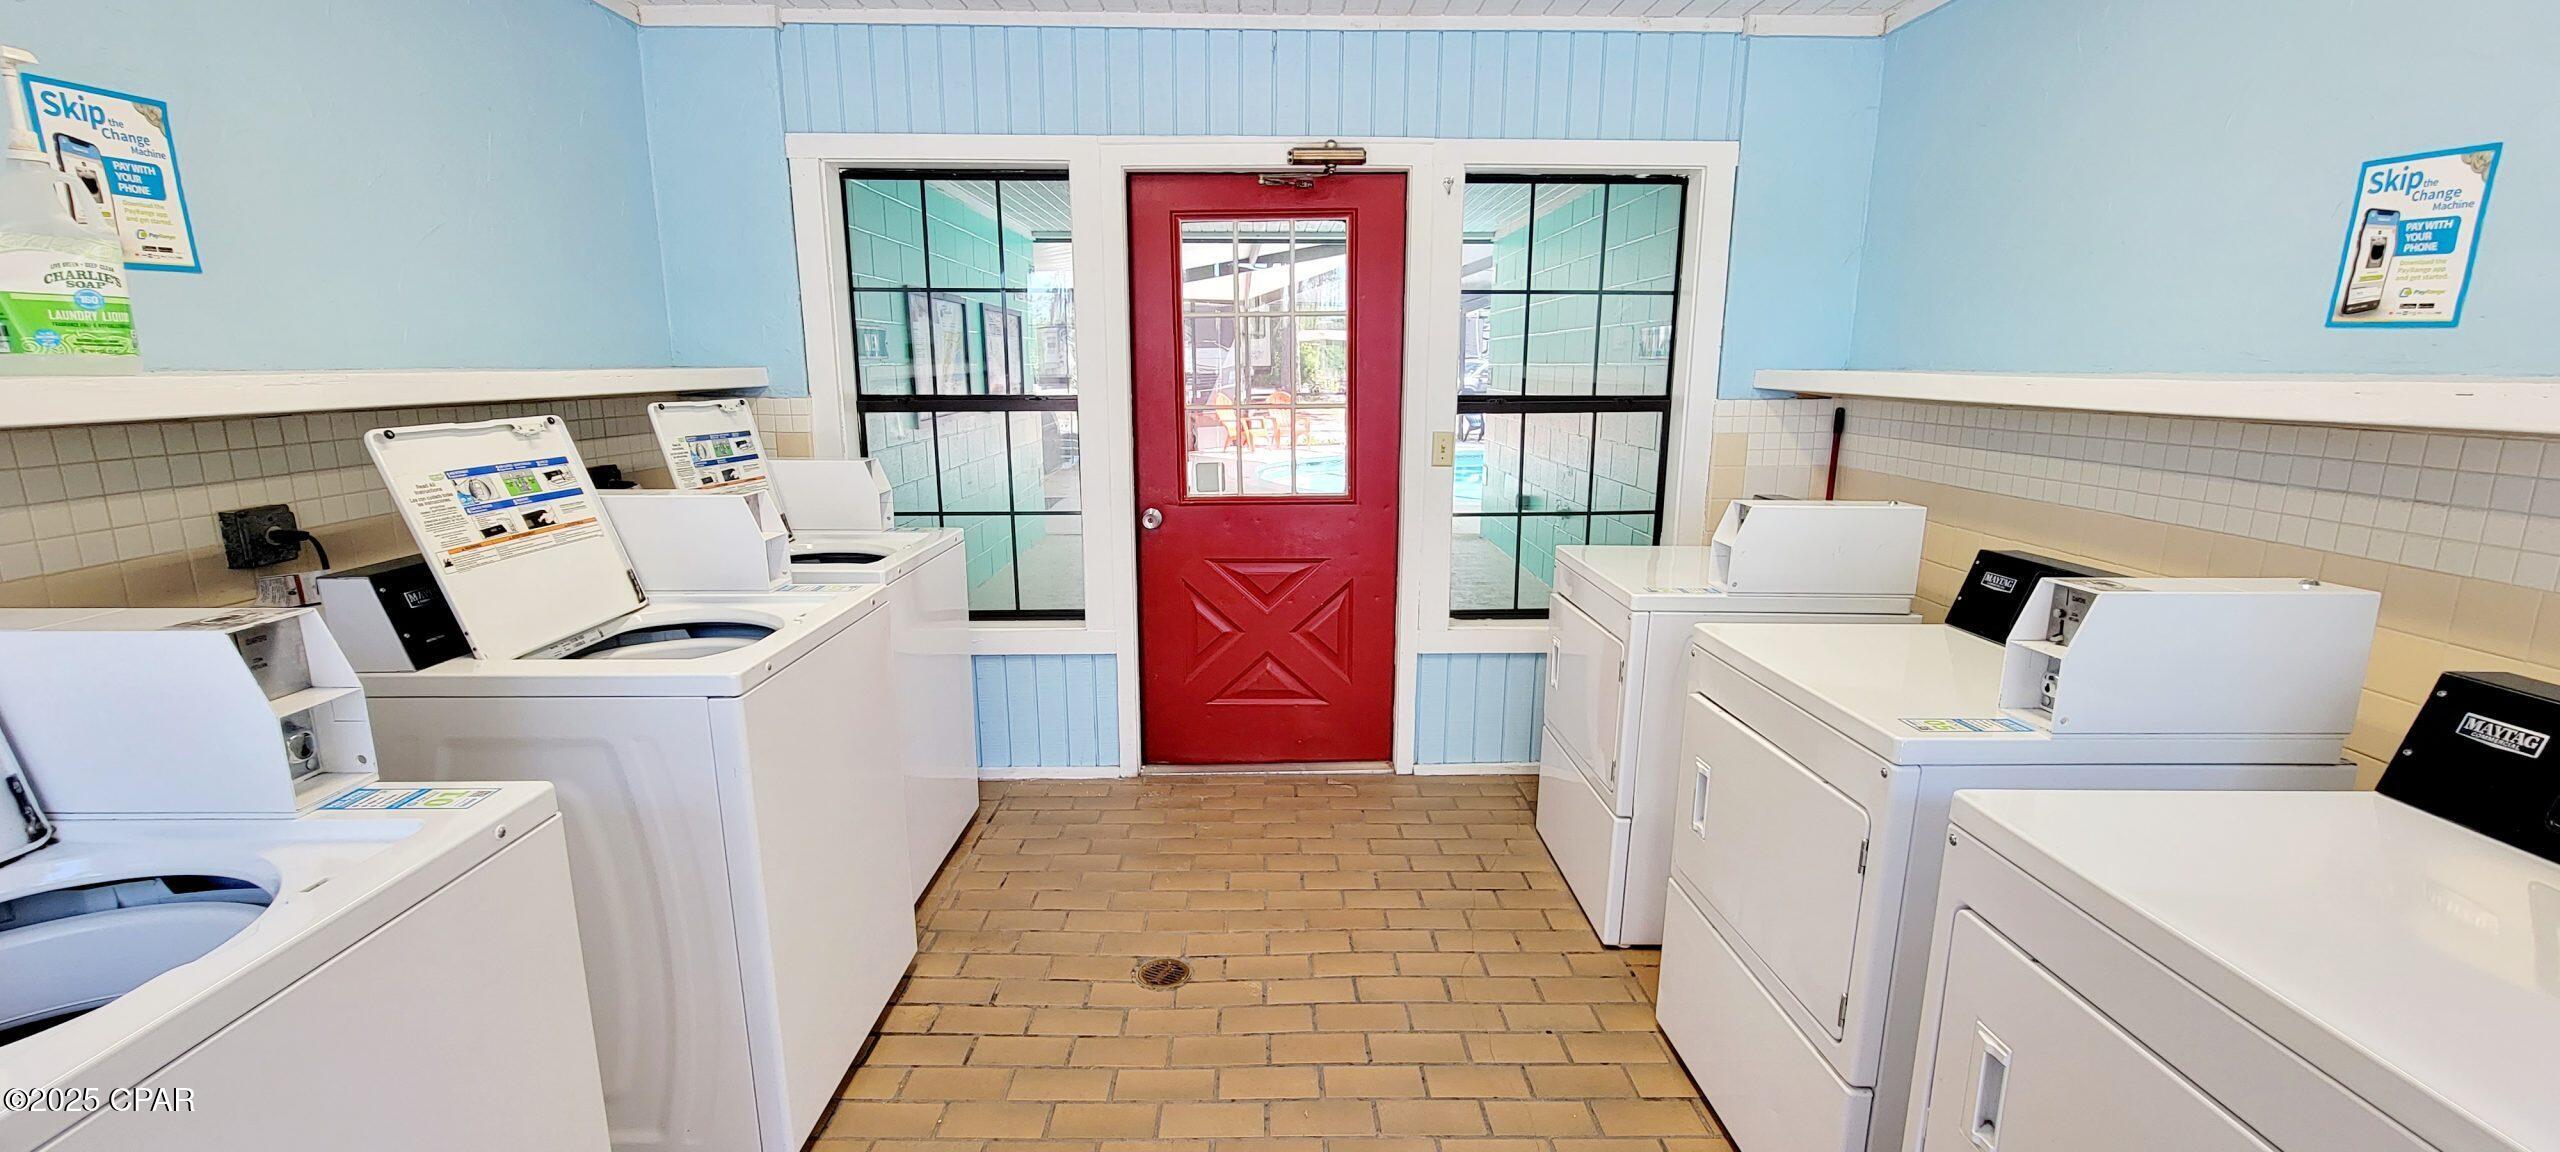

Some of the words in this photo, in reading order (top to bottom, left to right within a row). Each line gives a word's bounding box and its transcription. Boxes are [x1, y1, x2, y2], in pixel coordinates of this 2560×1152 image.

[40, 90, 106, 129] Skip
[108, 118, 124, 129] the
[102, 128, 150, 147] Change
[131, 147, 166, 159] Machine
[112, 160, 132, 172] PAY
[132, 163, 156, 175] WITH
[116, 173, 142, 184] YOUR
[2367, 165, 2424, 196] Skip
[2423, 177, 2439, 188] the
[119, 184, 151, 196] PHONE
[2411, 187, 2462, 202] Change
[2432, 200, 2475, 210] Machine
[2406, 222, 2425, 231] PAY
[2426, 220, 2454, 229] WITH
[2405, 232, 2432, 241] YOUR
[2403, 242, 2438, 252] PHONE
[44, 270, 121, 288] CHARLIE'S
[66, 281, 106, 289] SOAP
[49, 310, 97, 320] LAUNDRY
[1984, 573, 2014, 588] MAYTAG
[2463, 718, 2539, 750] MAYTAG
[2470, 731, 2521, 751] COMMERCIAL
